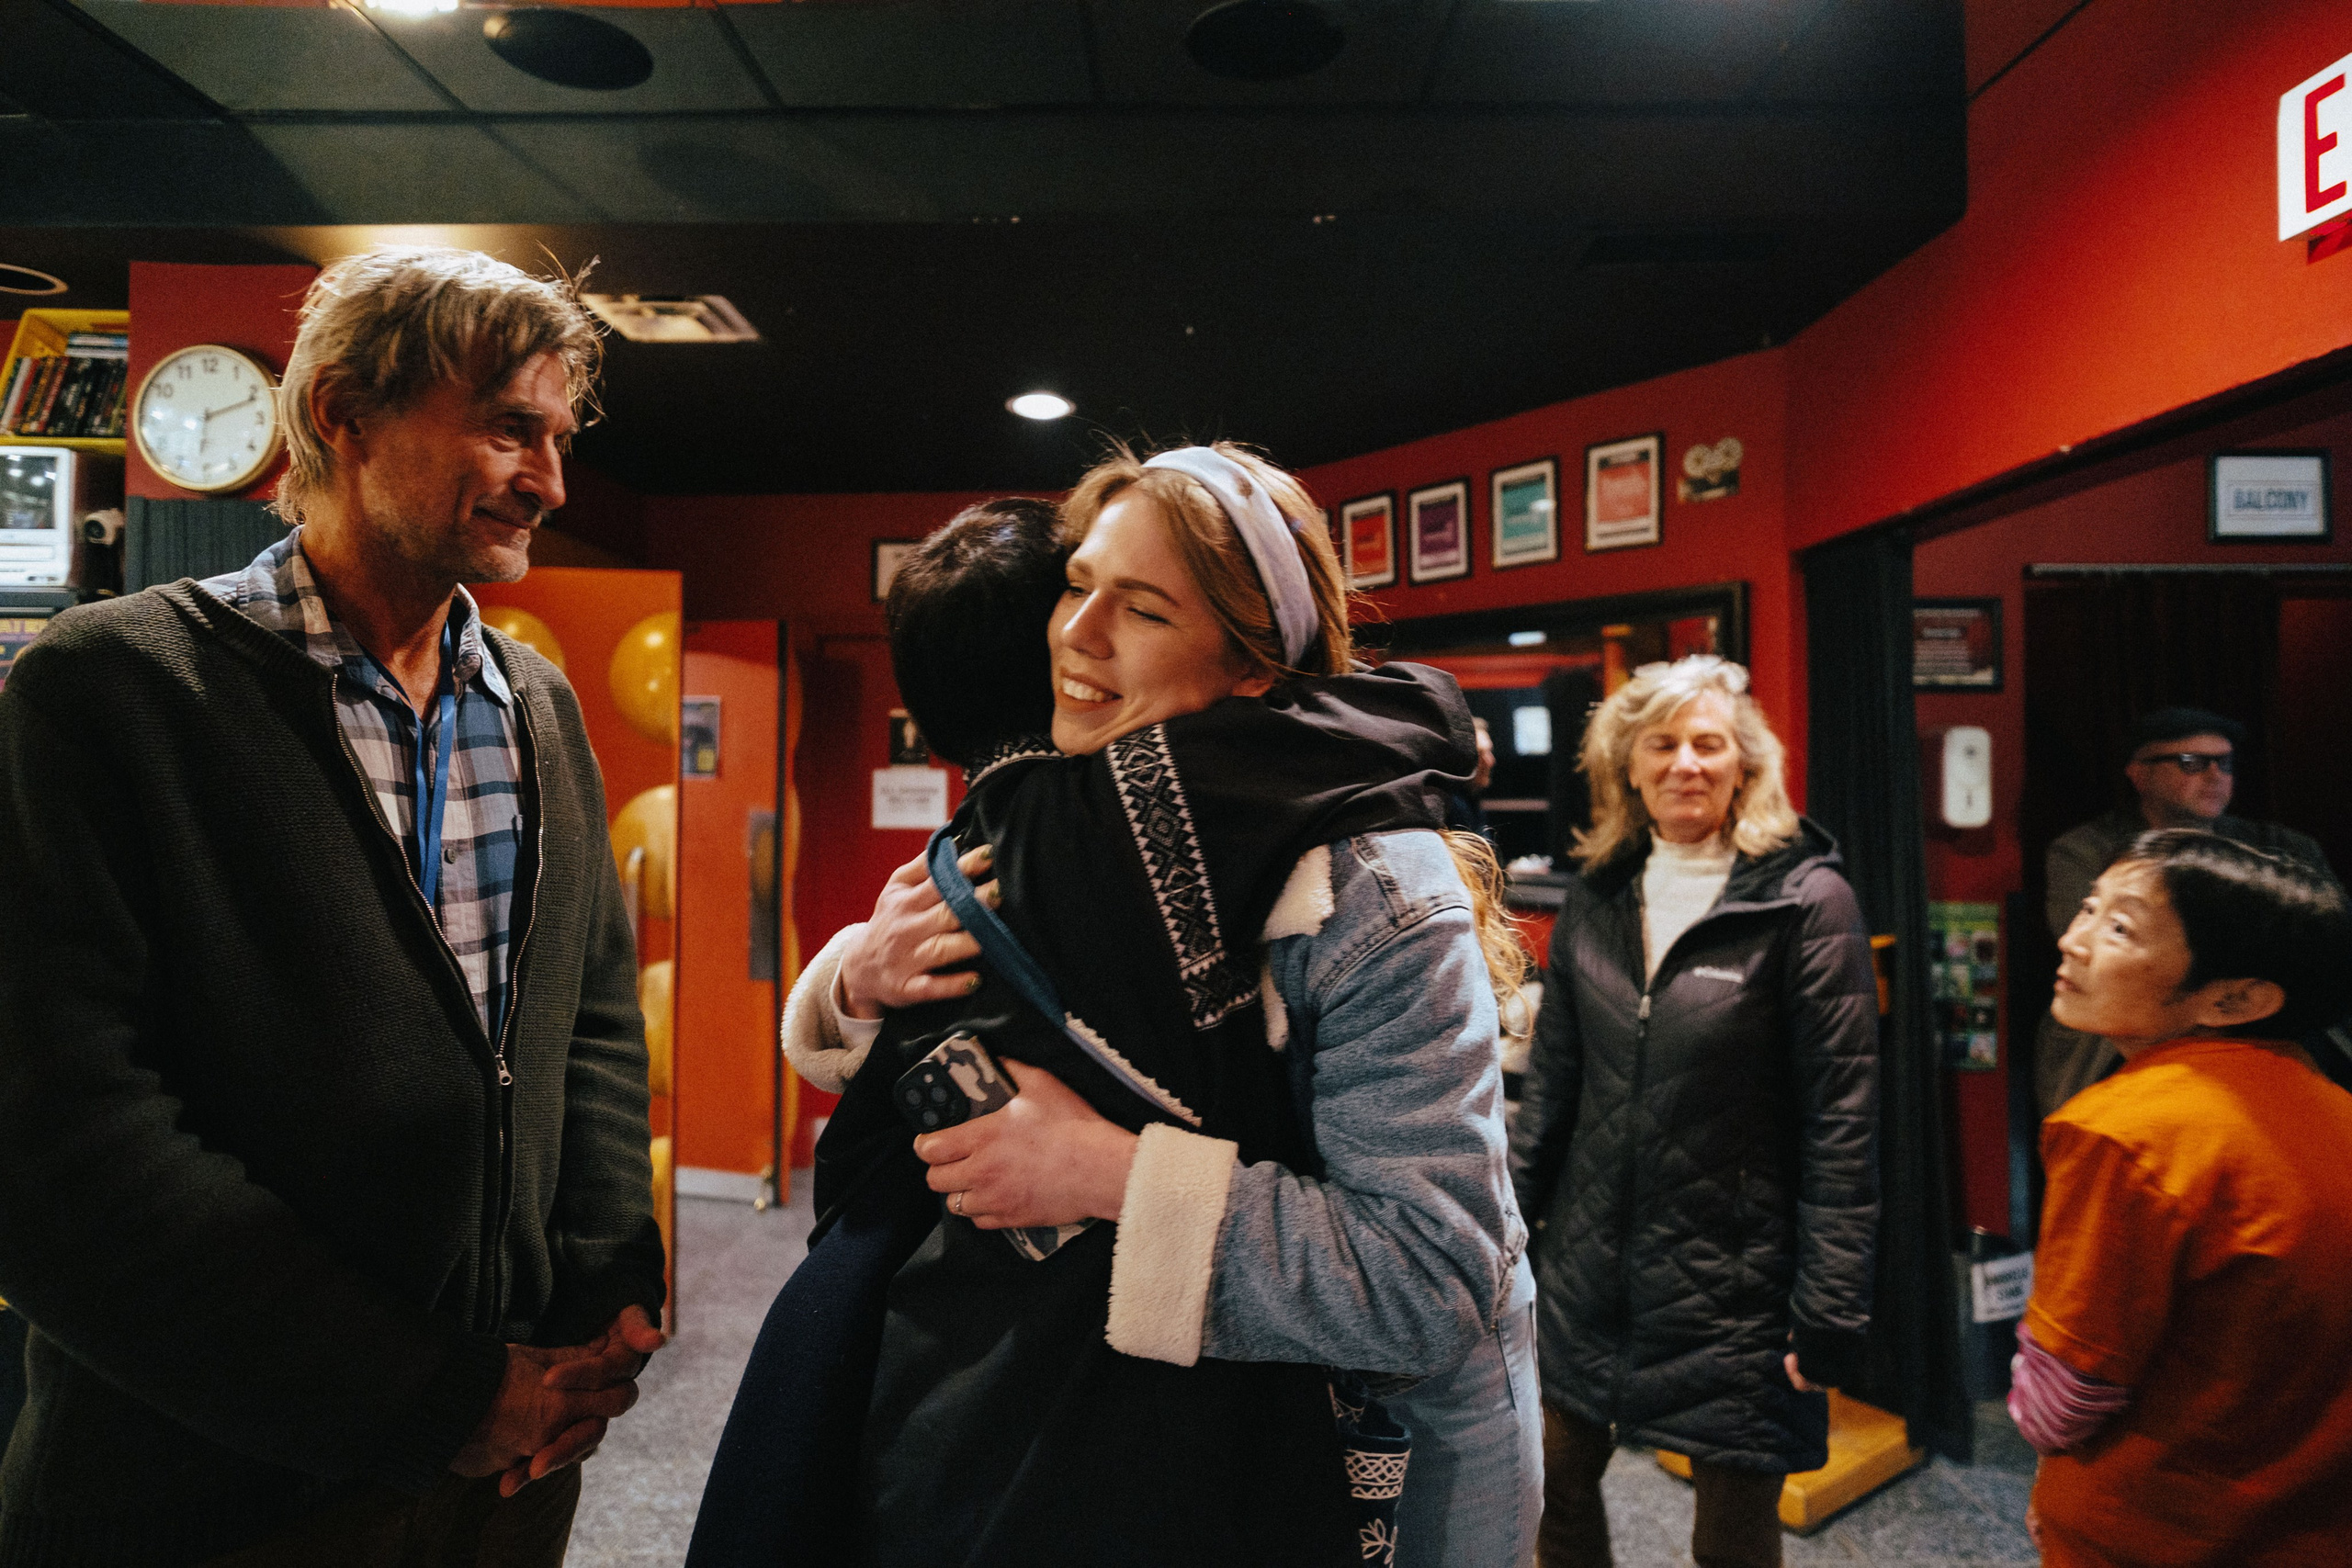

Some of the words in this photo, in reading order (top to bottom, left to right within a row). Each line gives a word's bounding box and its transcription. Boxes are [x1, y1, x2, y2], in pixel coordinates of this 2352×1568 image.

[177, 365, 192, 379] 11
[201, 356, 220, 374] 12
[153, 382, 174, 399] 10
[248, 384, 257, 401] 2
[254, 411, 265, 425] 3
[2234, 488, 2308, 510] BALCONY
